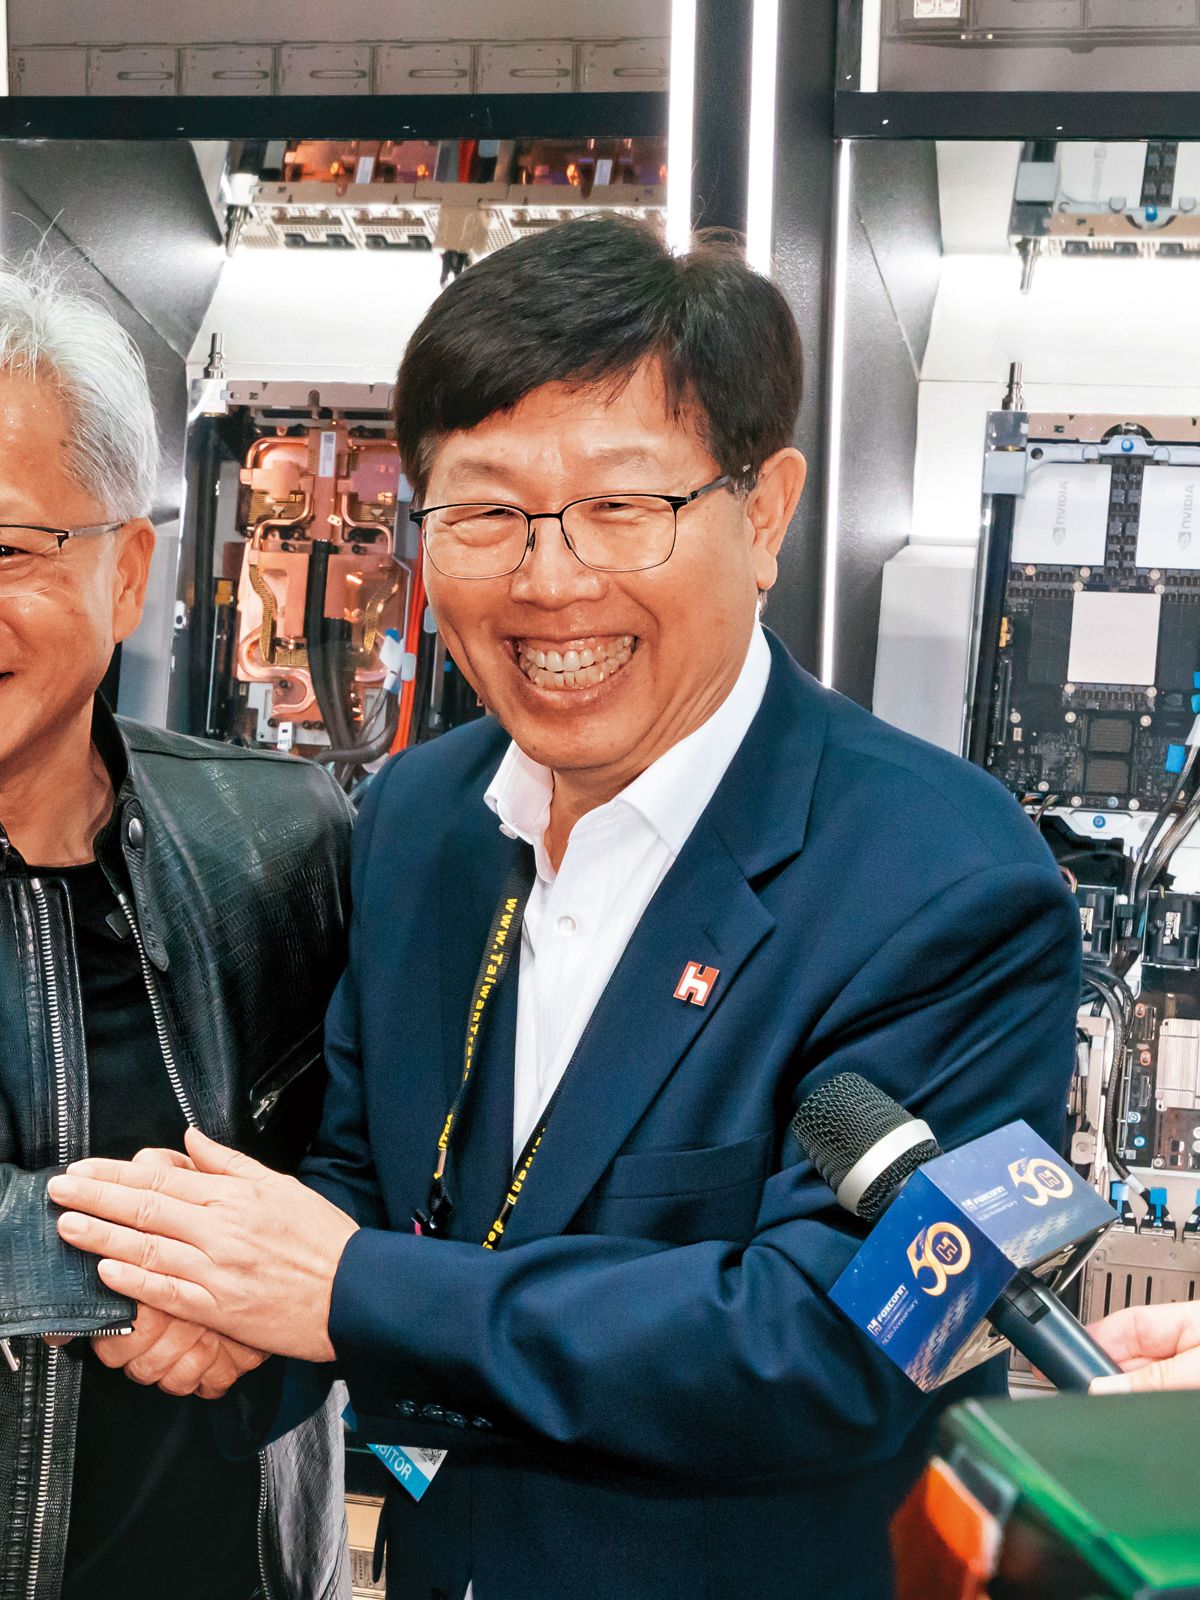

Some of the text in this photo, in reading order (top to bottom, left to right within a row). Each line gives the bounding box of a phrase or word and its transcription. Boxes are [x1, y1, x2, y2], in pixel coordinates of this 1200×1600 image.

[1181, 484, 1195, 529] NVIDIA
[1007, 1157, 1074, 1207] 50
[906, 1221, 972, 1297] 50
